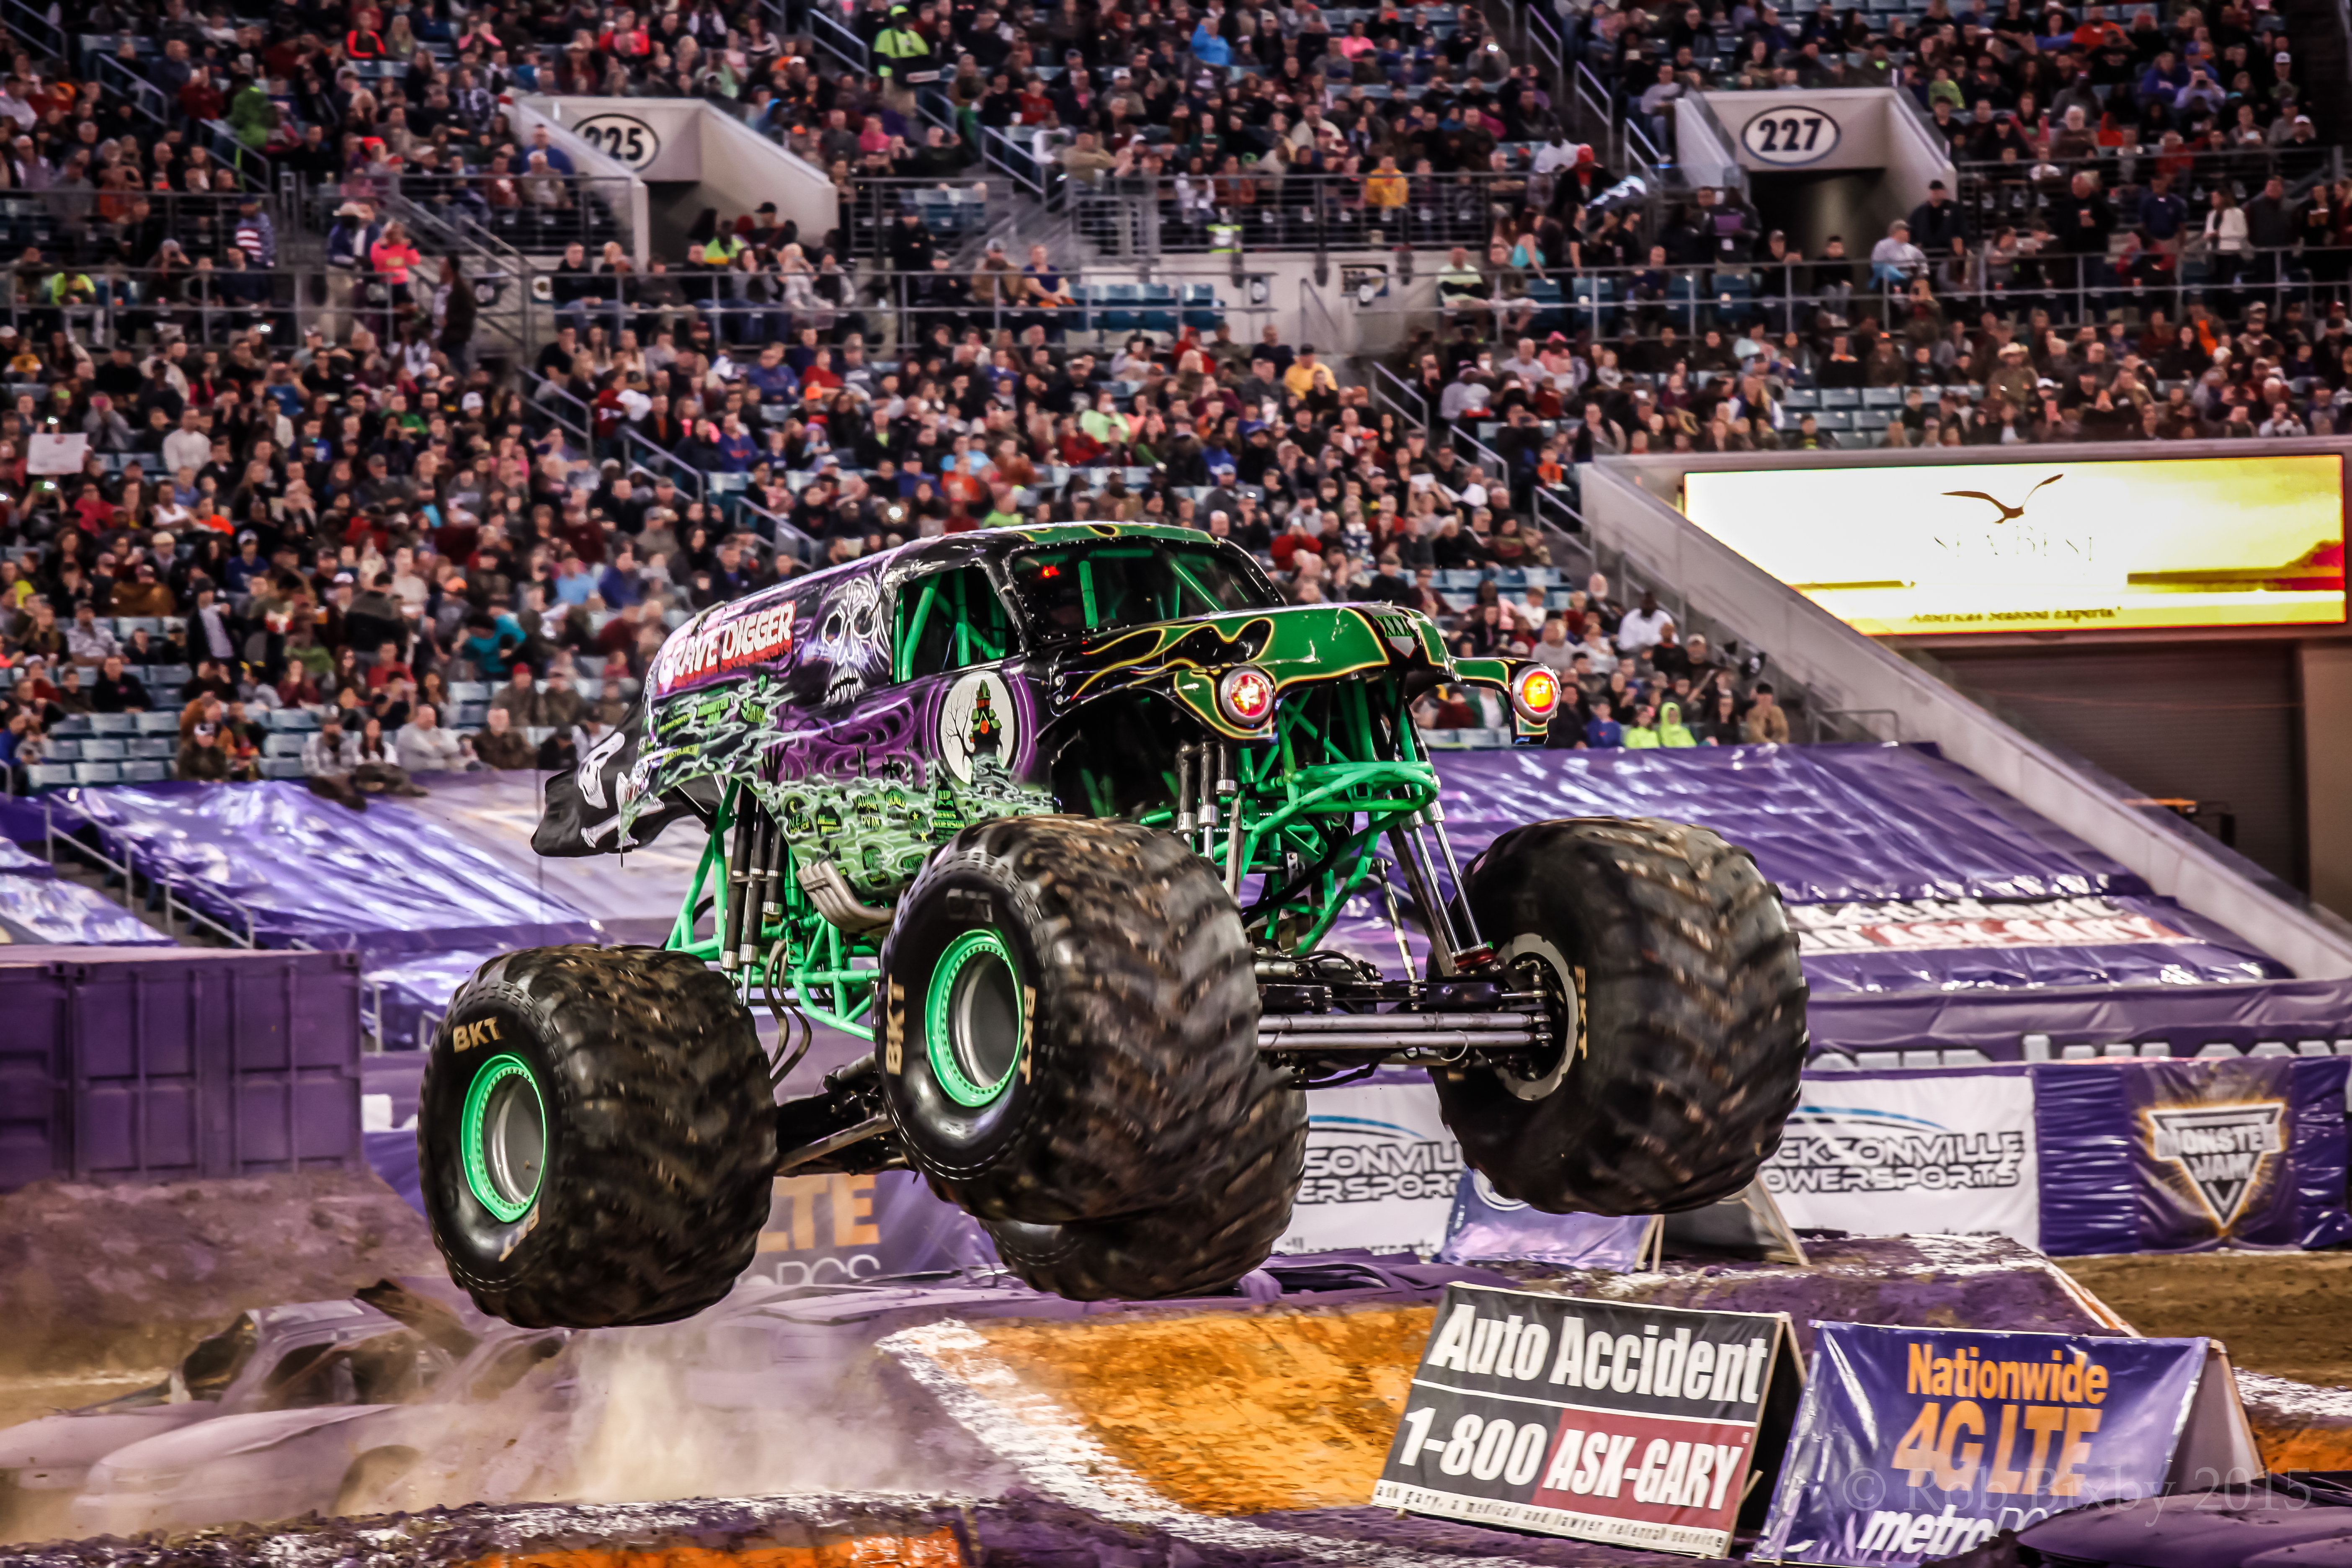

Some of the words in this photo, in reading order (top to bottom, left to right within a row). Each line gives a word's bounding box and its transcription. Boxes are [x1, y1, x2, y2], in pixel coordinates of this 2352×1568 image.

[585, 126, 643, 161] 225
[1759, 118, 1823, 152] 227
[658, 627, 720, 687] GRAVE
[721, 602, 795, 660] DIGGER
[453, 1016, 502, 1053] BKT
[885, 973, 905, 1075] BKT
[1020, 984, 1037, 1086] BKT
[1757, 1158, 2023, 1194] OWERSPORTS
[1774, 1131, 2024, 1168] CKSONVILLE
[1427, 1303, 1550, 1381] Auto
[1549, 1316, 1767, 1404] Accident
[1907, 1343, 2110, 1405] Nationwide
[1399, 1407, 1547, 1486] 1-800
[1542, 1429, 1744, 1510] ASK-GARY
[1891, 1400, 1986, 1492] 4G
[1985, 1404, 2103, 1497] LTE
